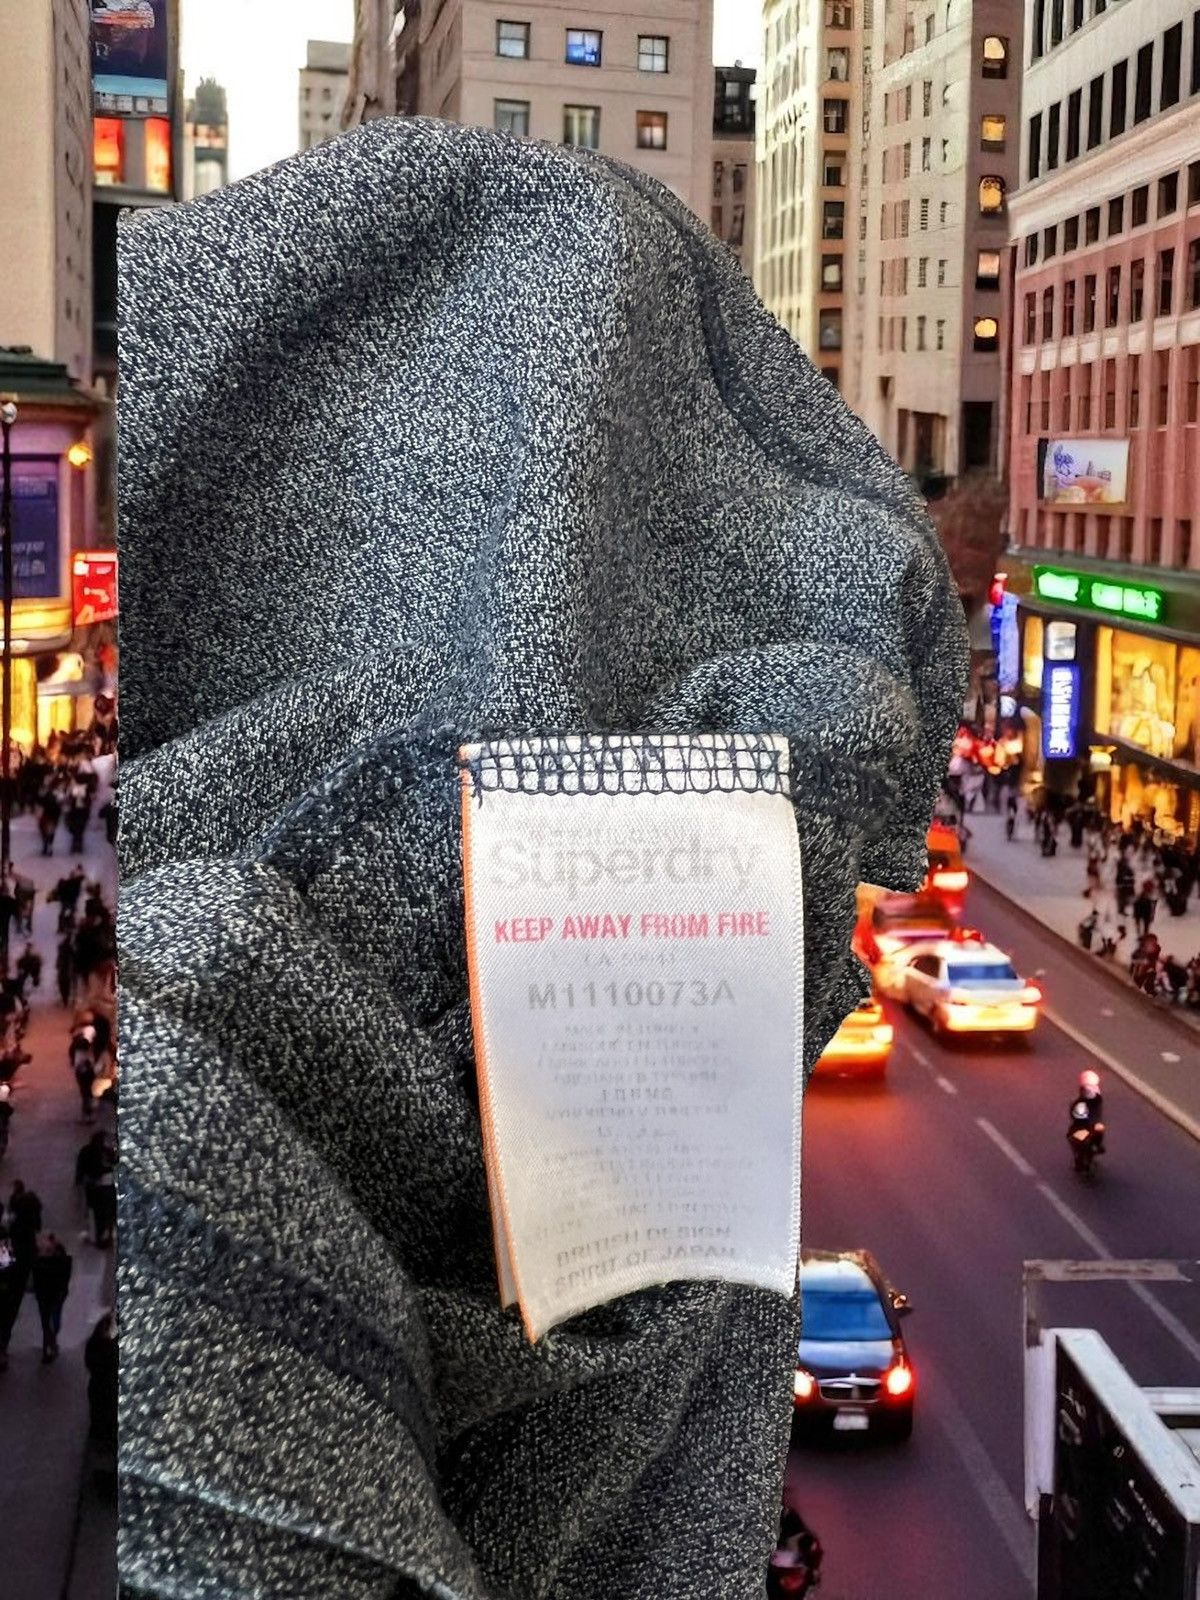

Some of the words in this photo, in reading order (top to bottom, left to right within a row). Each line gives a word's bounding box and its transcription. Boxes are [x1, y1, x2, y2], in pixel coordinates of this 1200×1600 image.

[490, 834, 762, 901] Superdry
[494, 917, 553, 943] KEEP
[562, 914, 632, 940] AWAY
[640, 912, 709, 939] FROM
[717, 910, 771, 937] FIRE
[529, 979, 735, 1010] M1110073A
